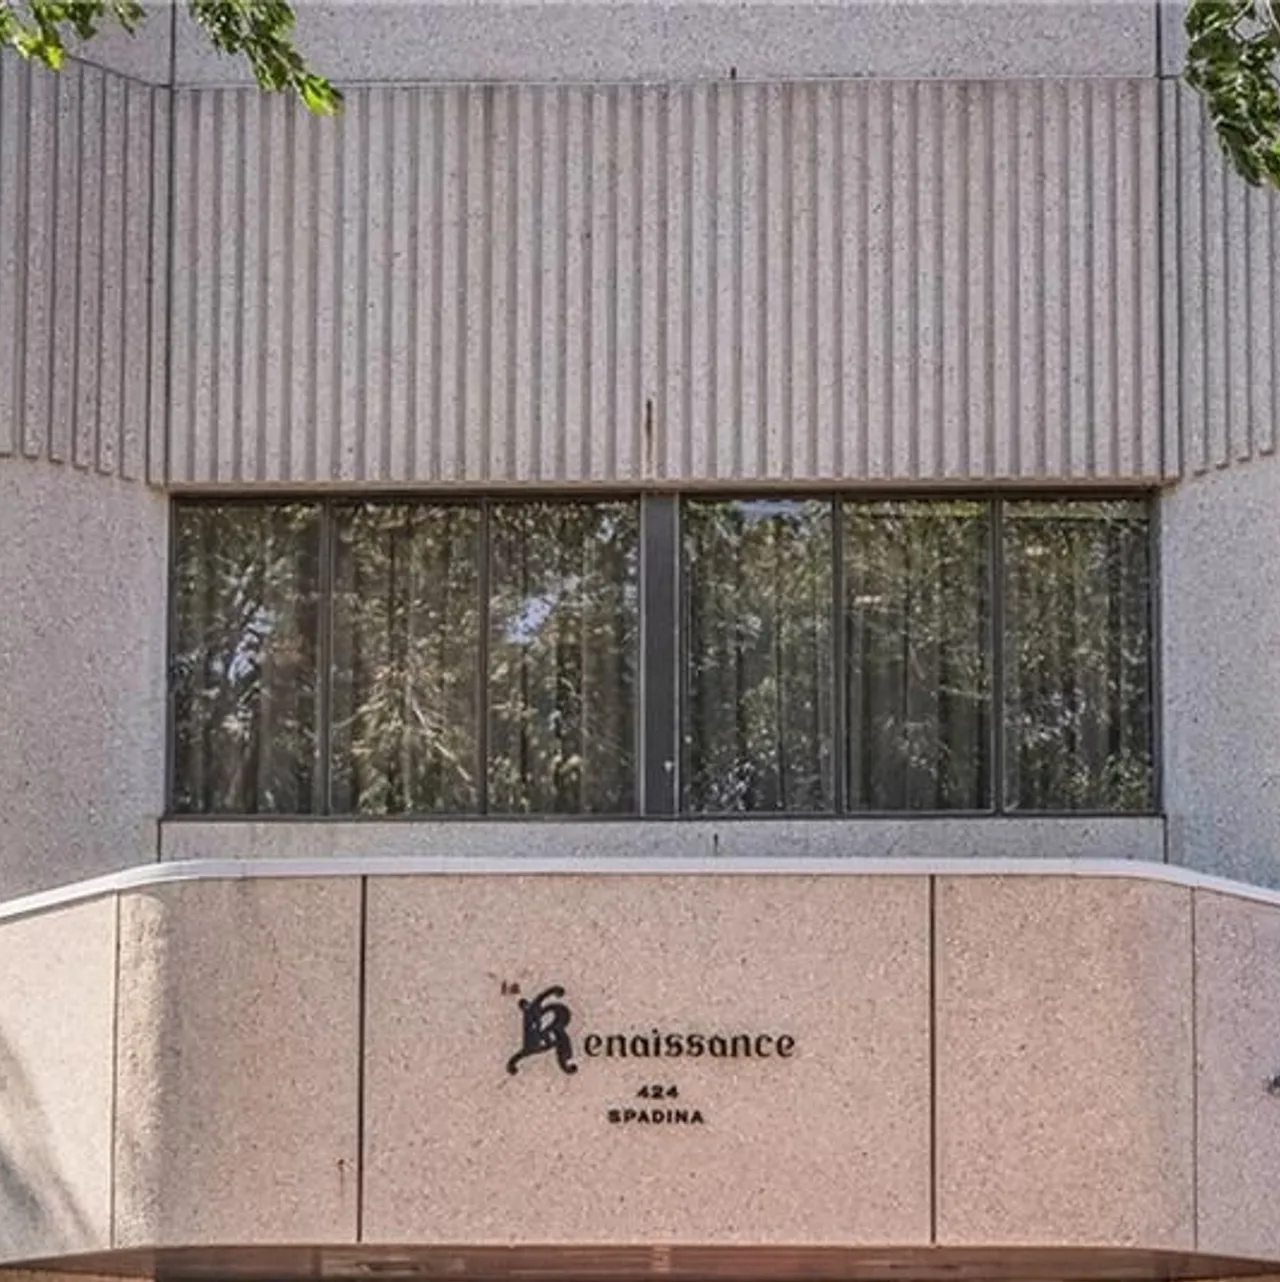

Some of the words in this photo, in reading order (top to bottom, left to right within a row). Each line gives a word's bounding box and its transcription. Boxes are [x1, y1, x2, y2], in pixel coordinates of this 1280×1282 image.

[506, 985, 796, 1075] Renaissance
[637, 1085, 679, 1099] 424
[608, 1109, 704, 1124] SPADINA
